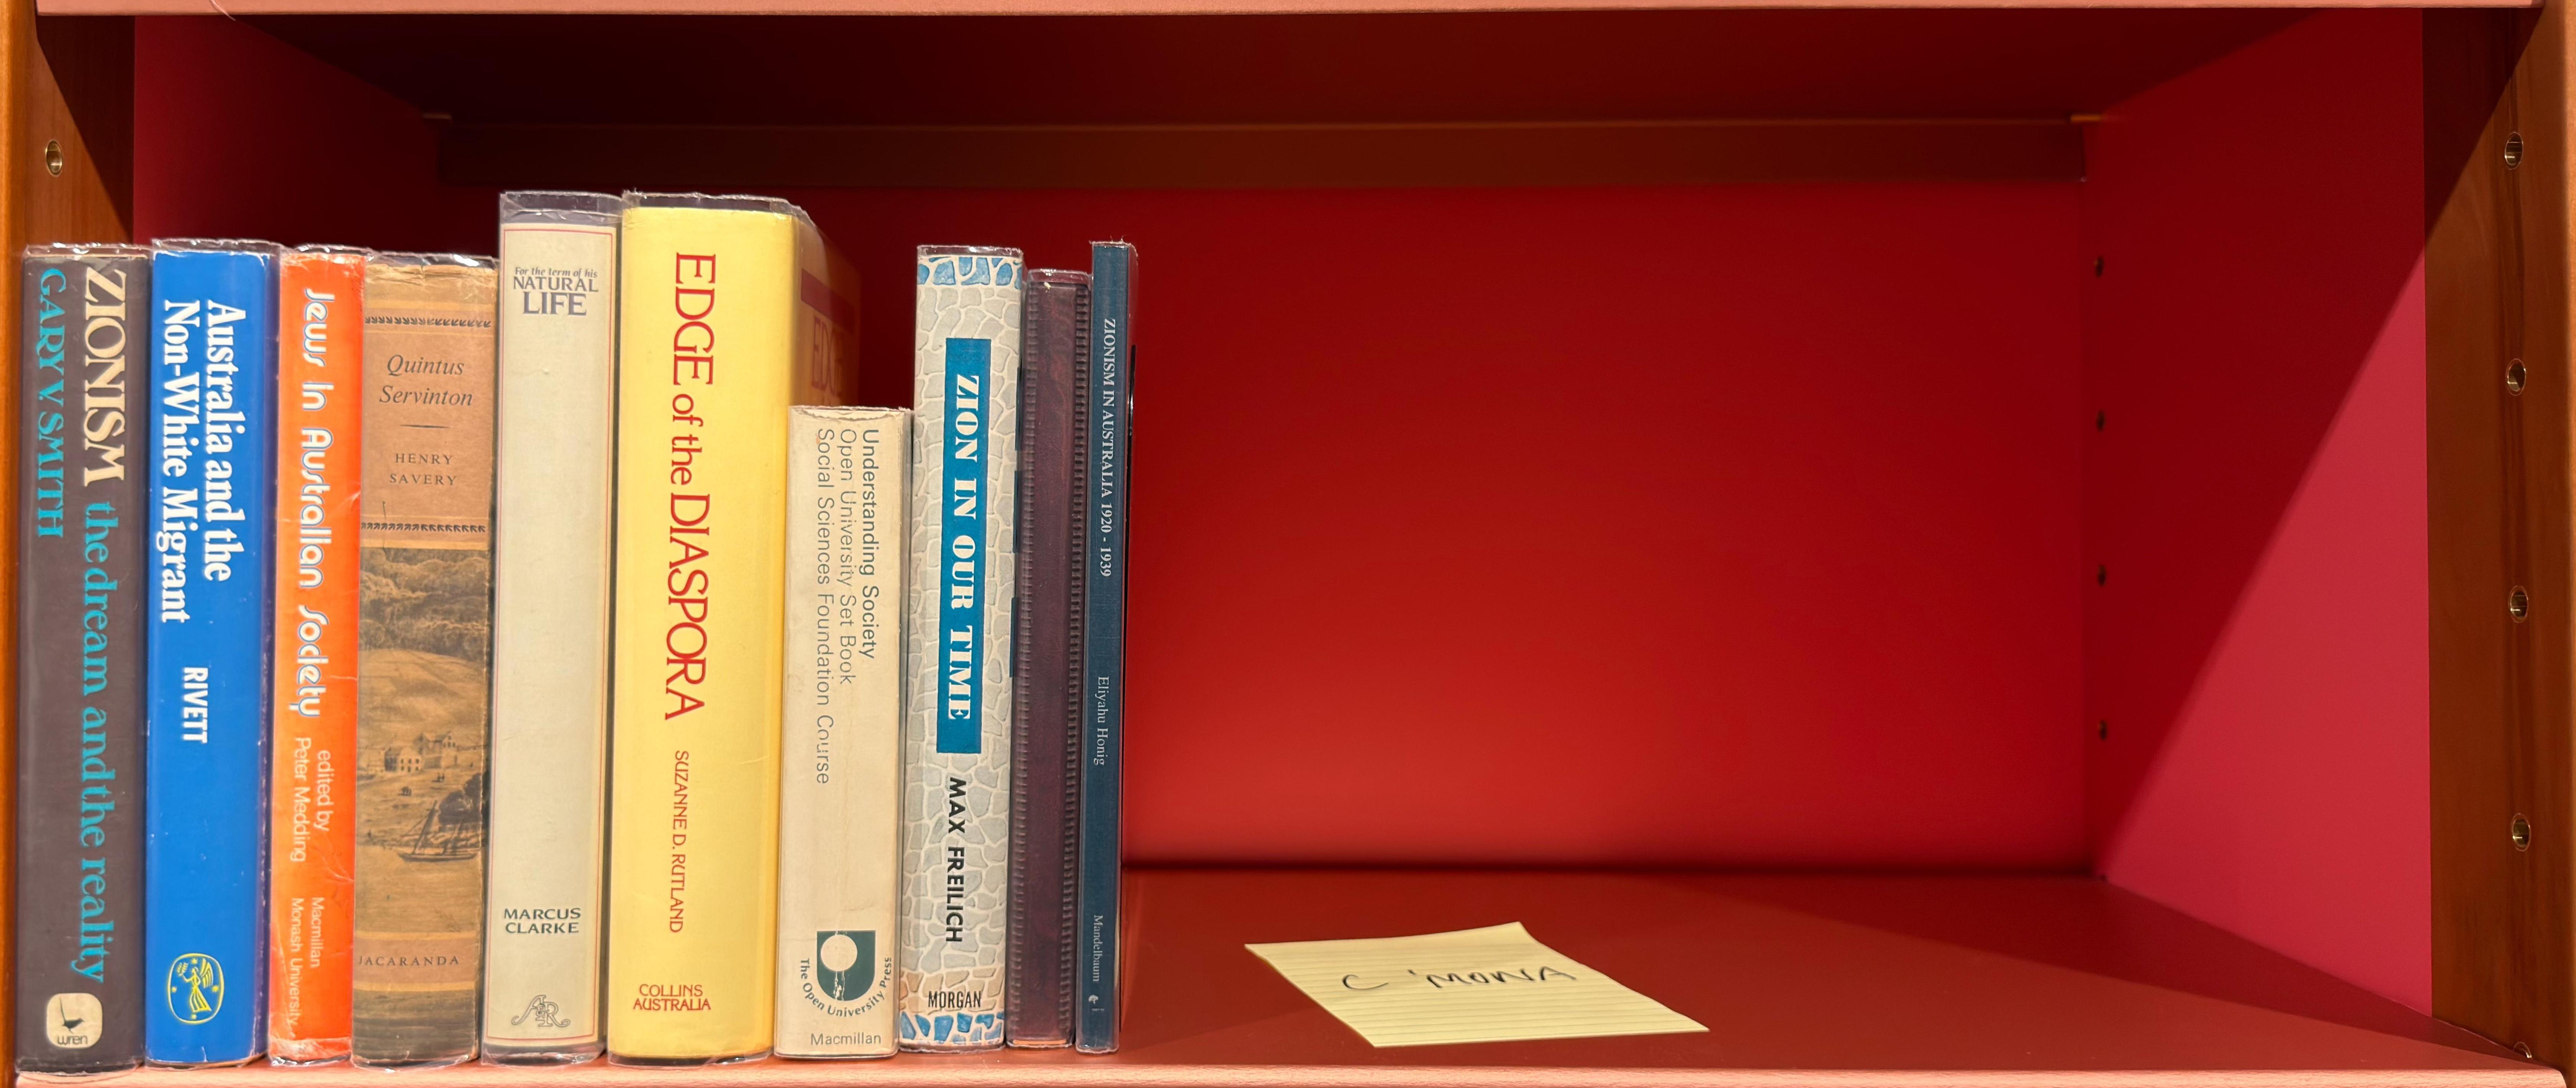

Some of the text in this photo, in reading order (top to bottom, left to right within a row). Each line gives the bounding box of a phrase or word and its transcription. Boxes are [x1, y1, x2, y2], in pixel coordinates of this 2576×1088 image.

[513, 276, 599, 292] NATURAL
[515, 266, 598, 279] For the term of his
[523, 291, 587, 316] LIFE
[35, 268, 65, 376] GARY
[302, 288, 335, 367] Jews
[1103, 318, 1116, 386] ZIONISM
[379, 385, 472, 406] Servinton
[387, 354, 464, 377] Quintus
[1103, 390, 1114, 407] IN
[37, 411, 64, 538] SMITH
[156, 300, 200, 623] Non-White Migrant
[203, 300, 246, 581] Australia and the
[395, 453, 453, 465] HENRY
[1102, 410, 1114, 498] AUSTRALIA
[390, 473, 457, 486] SAVERY
[665, 252, 716, 721] EDGE of the DIASPORA
[859, 429, 879, 659] Understanding Society
[948, 374, 979, 719] ZION IN OUR TIME
[1101, 503, 1113, 533] 1920
[836, 429, 857, 685] Open University Set Book
[1100, 547, 1112, 577] 1939
[70, 267, 127, 983] ZIONISM the dream and the reality
[816, 429, 835, 784] Social Sciences Foundation Course
[182, 667, 208, 744] RIVETT
[1093, 676, 1109, 765] Eliyahu Honig
[290, 737, 312, 862] Peter Medding
[313, 750, 334, 831] edited by
[669, 750, 689, 933] SUZANNE D. RUTLAND
[946, 777, 967, 942] MAX FREILICH
[310, 896, 325, 969] Macmillan
[504, 907, 581, 920] MARCUS
[505, 922, 579, 934] CLARKE
[288, 897, 305, 1026] Monash University
[359, 956, 459, 967] JACARANDA
[1093, 915, 1103, 981] Mandelbaum
[633, 998, 711, 1011] AUSTRALIA
[639, 984, 703, 997] COLLINS
[800, 957, 892, 1017] The Open University Press
[928, 991, 982, 1008] MORGAN
[57, 1035, 88, 1045] wren
[811, 1032, 881, 1045] Macmillan
